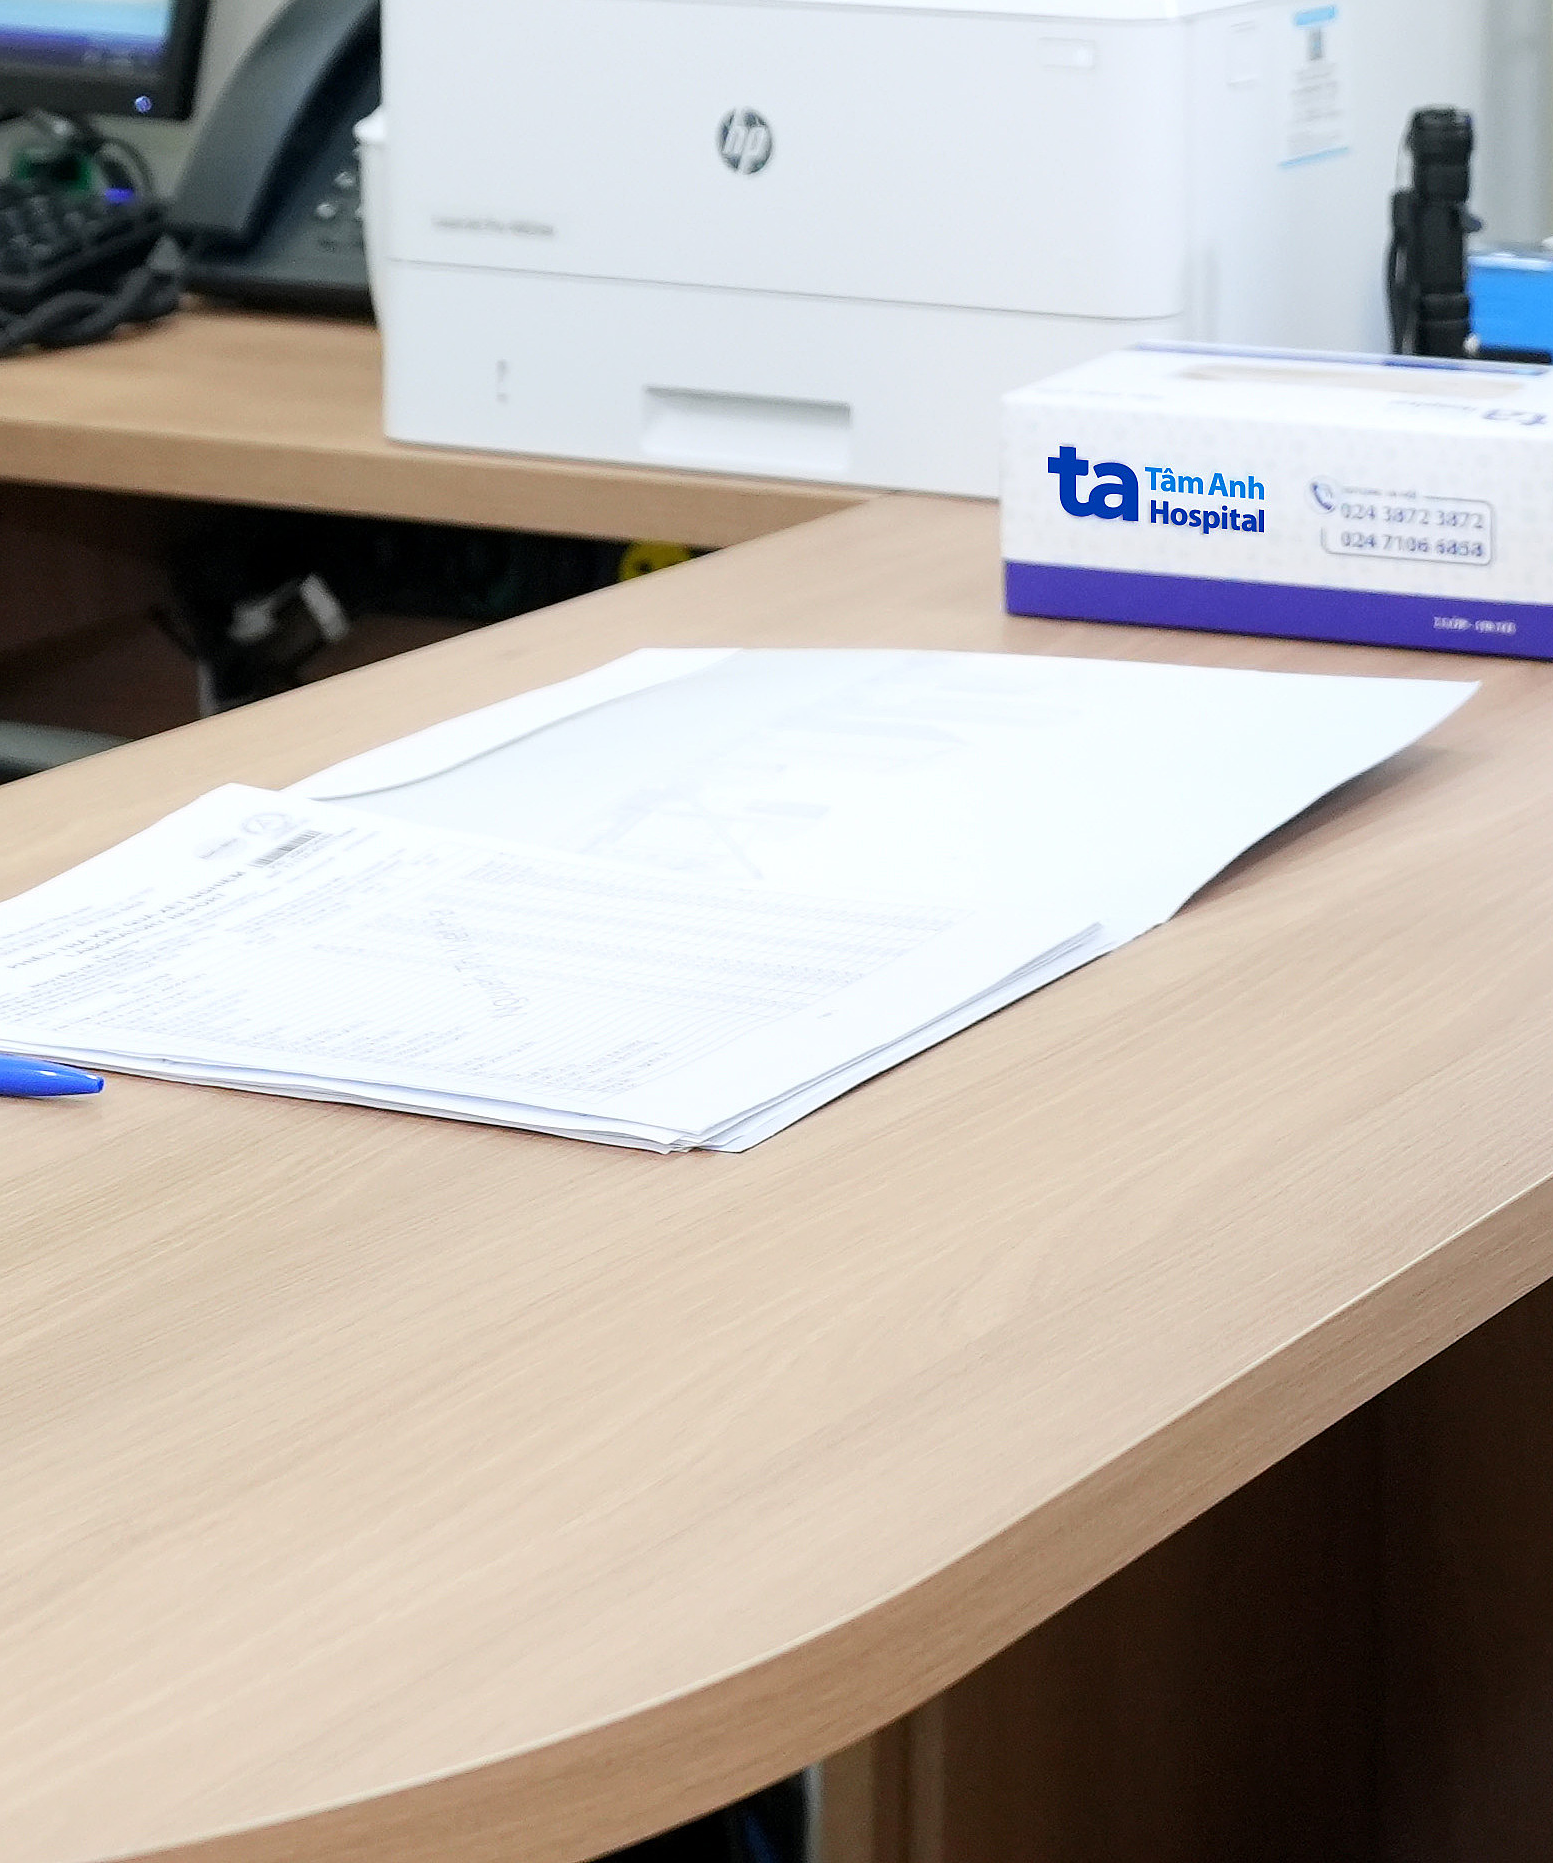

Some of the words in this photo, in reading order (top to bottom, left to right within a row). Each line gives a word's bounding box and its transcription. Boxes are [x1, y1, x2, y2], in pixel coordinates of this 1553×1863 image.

[718, 107, 772, 175] hp
[1047, 445, 1139, 522] ta
[1144, 466, 1204, 495] Tâm
[1207, 472, 1265, 501] Anh
[1150, 499, 1265, 535] Hospital
[1341, 502, 1376, 520] 024
[1341, 531, 1377, 548] 024
